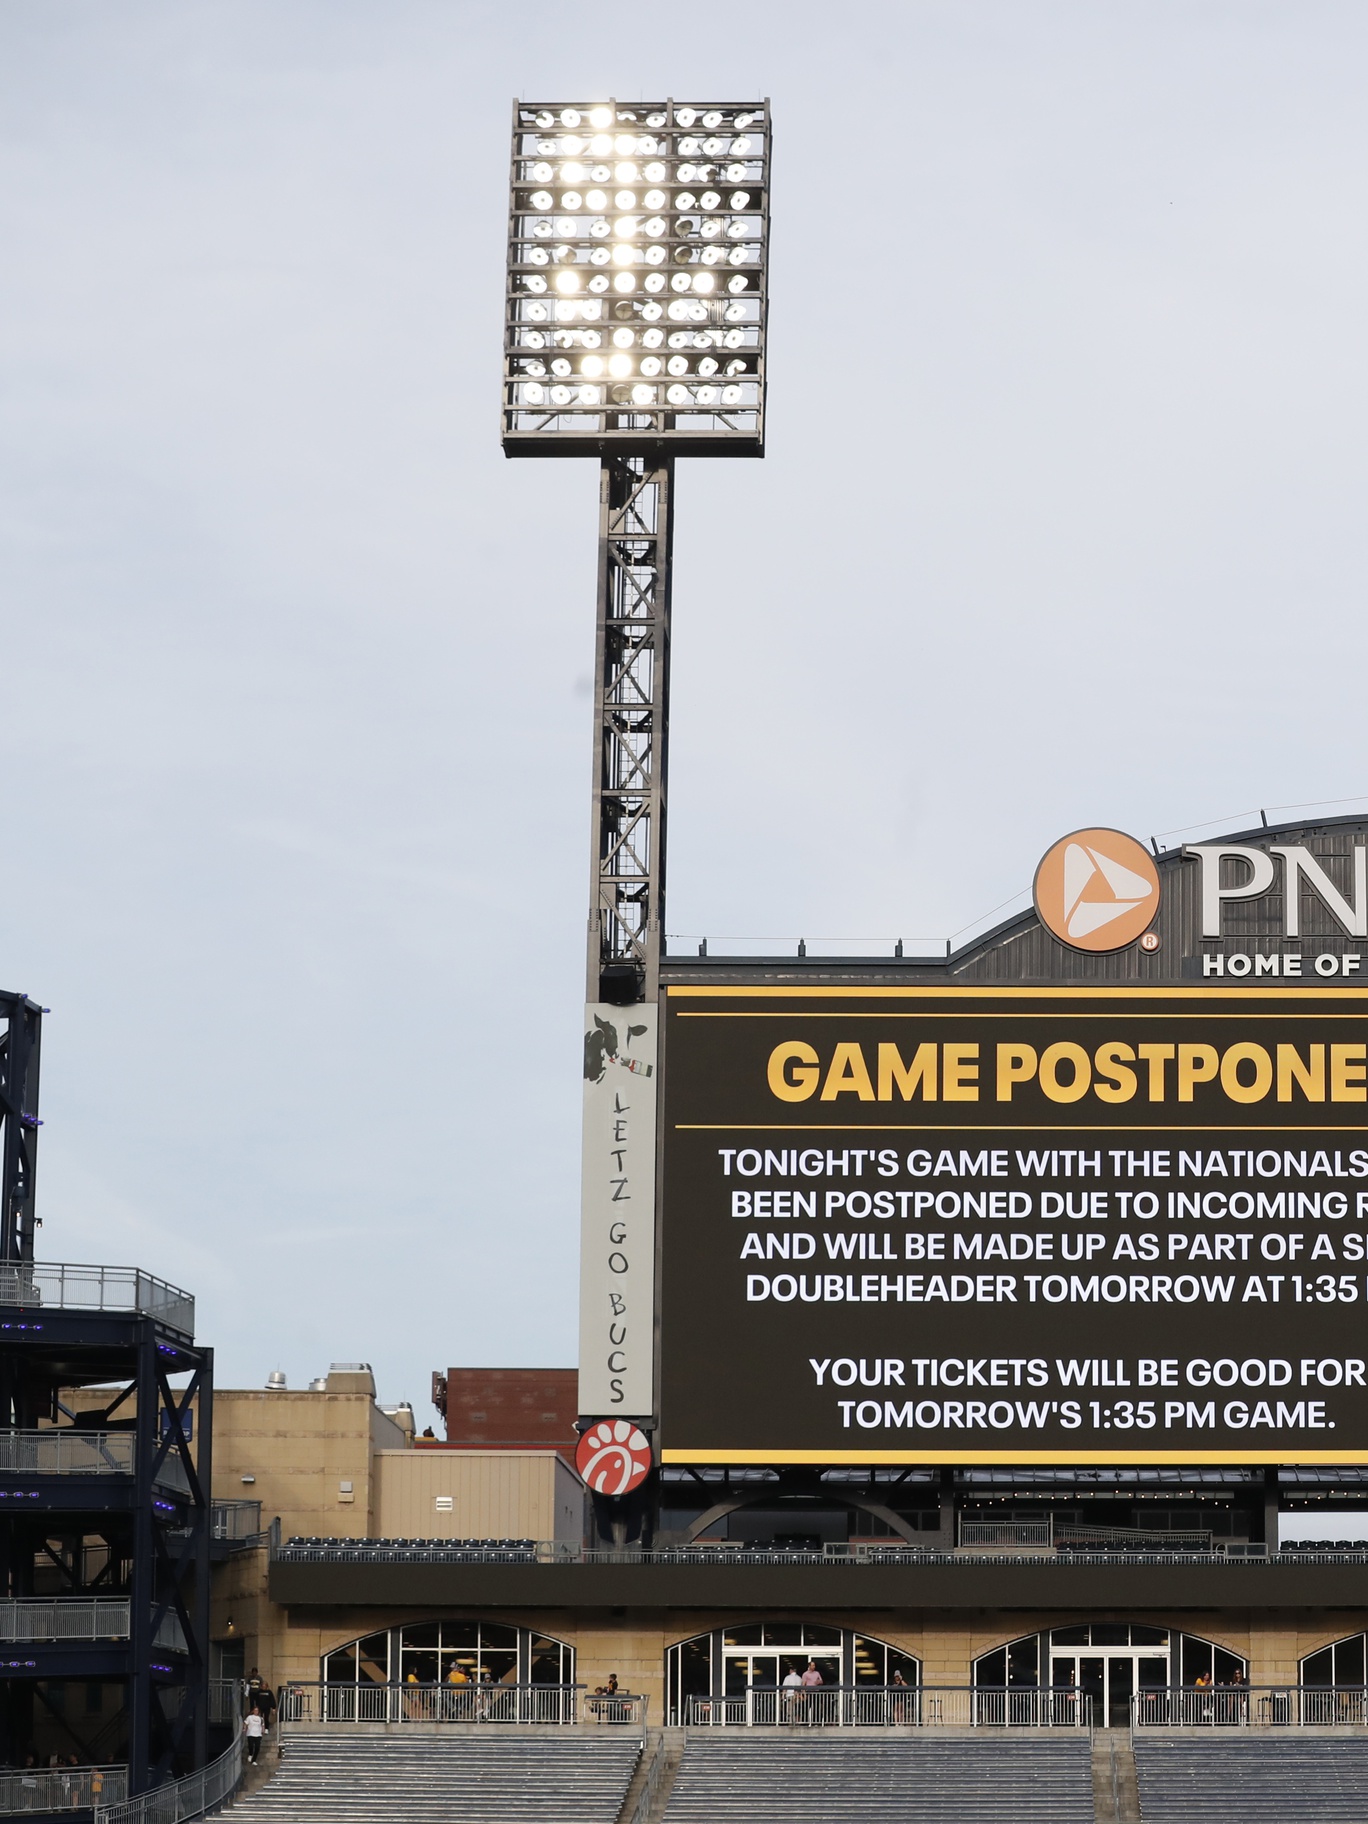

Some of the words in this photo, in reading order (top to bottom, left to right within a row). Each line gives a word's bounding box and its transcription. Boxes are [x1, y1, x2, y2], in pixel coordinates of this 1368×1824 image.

[1203, 953, 1302, 977] HOME
[1314, 953, 1361, 977] OF
[766, 1040, 980, 1103] GAME
[609, 1093, 631, 1202] LETZ
[718, 1148, 900, 1177] TONIGHT'S
[906, 1149, 1009, 1177] GAME
[1015, 1150, 1101, 1177] WITH
[1108, 1150, 1171, 1177] THE
[731, 1190, 817, 1218] BEEN
[825, 1190, 1033, 1219] POSTPONED
[1040, 1191, 1108, 1219] DUE
[1114, 1191, 1160, 1219] TO
[1167, 1191, 1348, 1219] INCOMING
[608, 1222, 629, 1274] GO
[739, 1232, 816, 1260] AND
[822, 1232, 898, 1260] WILL
[905, 1233, 946, 1260] BE
[953, 1233, 1054, 1260] MADE
[1061, 1233, 1106, 1261] UP
[1112, 1233, 1160, 1261] AS
[1168, 1233, 1254, 1261] PART
[1260, 1233, 1304, 1261] OF
[1310, 1233, 1337, 1260] A
[746, 1273, 1018, 1302] DOUBLEHEADER
[1023, 1274, 1236, 1303] TOMORROW
[1241, 1275, 1285, 1303] AT
[1291, 1274, 1359, 1303] 1:35
[607, 1293, 628, 1403] BUCS
[808, 1358, 906, 1387] YOUR
[911, 1358, 1049, 1387] TICKETS
[1055, 1359, 1131, 1387] WILL
[1138, 1359, 1179, 1386] BE
[1185, 1358, 1293, 1387] GOOD
[1300, 1358, 1367, 1387] FOR
[837, 1400, 1082, 1429] TOMORROW'S
[1088, 1400, 1157, 1429] 1:35
[1164, 1401, 1216, 1429] PM
[1223, 1400, 1336, 1429] GAME.
